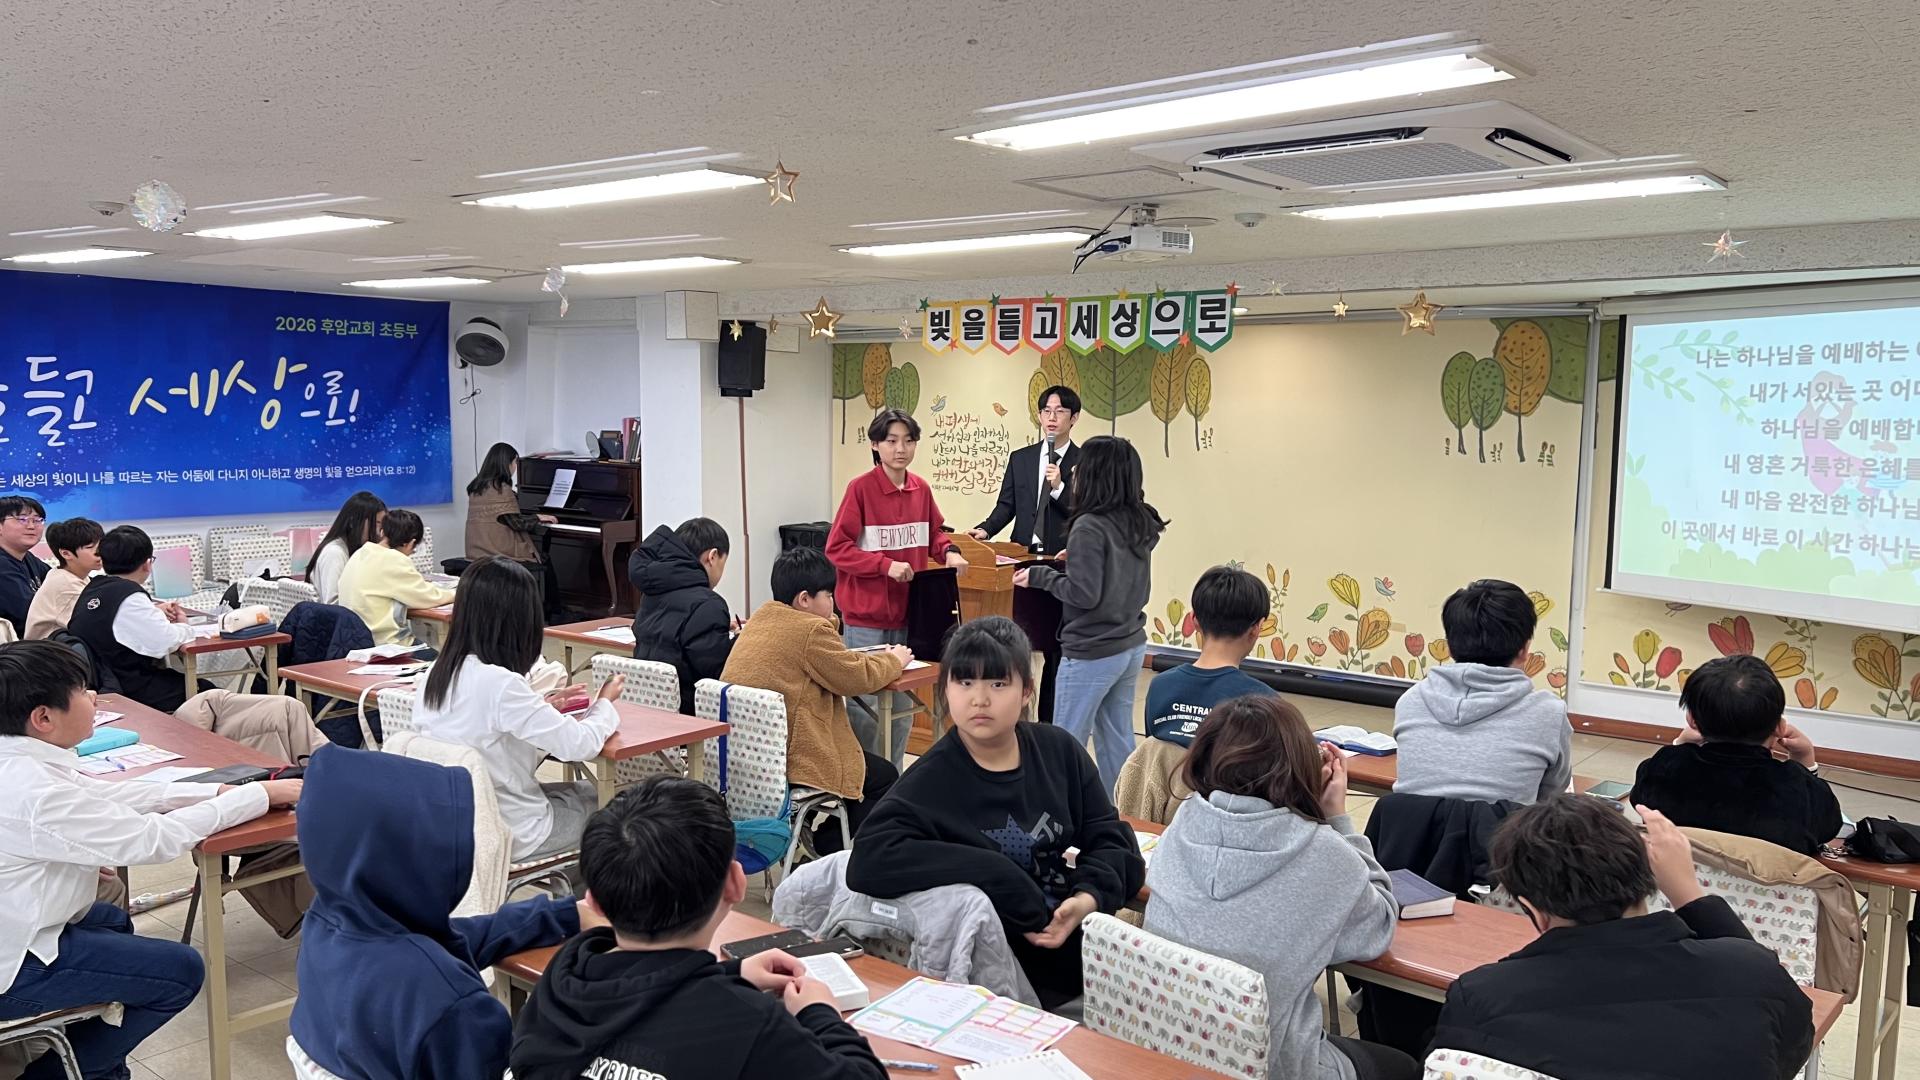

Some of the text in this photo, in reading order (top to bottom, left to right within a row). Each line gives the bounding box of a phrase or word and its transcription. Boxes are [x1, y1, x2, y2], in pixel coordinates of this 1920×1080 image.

[275, 316, 419, 339] 2026 후암교회 초등부
[1696, 348, 1731, 369] 나는
[1737, 344, 1815, 368] 하나님을
[1821, 341, 1909, 365] 예배하는
[24, 356, 97, 447] 들고
[1749, 381, 1788, 403] 내가
[1792, 381, 1856, 403] 서있는
[1862, 380, 1883, 402] 곳
[935, 414, 944, 428] 내
[1761, 418, 1920, 441] 하나님을 예배합
[10, 472, 48, 488] 세상의
[52, 471, 89, 486] 빛이니
[93, 471, 115, 485] 나를
[119, 470, 152, 484] 따르는
[156, 470, 178, 483] 자는
[182, 469, 214, 483] 어둠에
[218, 468, 248, 481] 다니지
[252, 467, 291, 481] 아니하고
[294, 467, 322, 480] 생명의
[325, 465, 342, 479] 빛을
[345, 465, 381, 478] 얻으리라
[1724, 453, 1920, 481] 내 영혼 거룩한 은혜를
[1721, 489, 1739, 510] 내
[1744, 490, 1783, 512] 마음
[1787, 492, 1851, 516] 완전한
[877, 525, 918, 548] EWYOR
[1661, 520, 1676, 540] 이
[1682, 521, 1736, 544] 곳에서
[1742, 526, 1780, 547] 바로
[1786, 529, 1804, 550] 이
[1810, 531, 1853, 554] 시간
